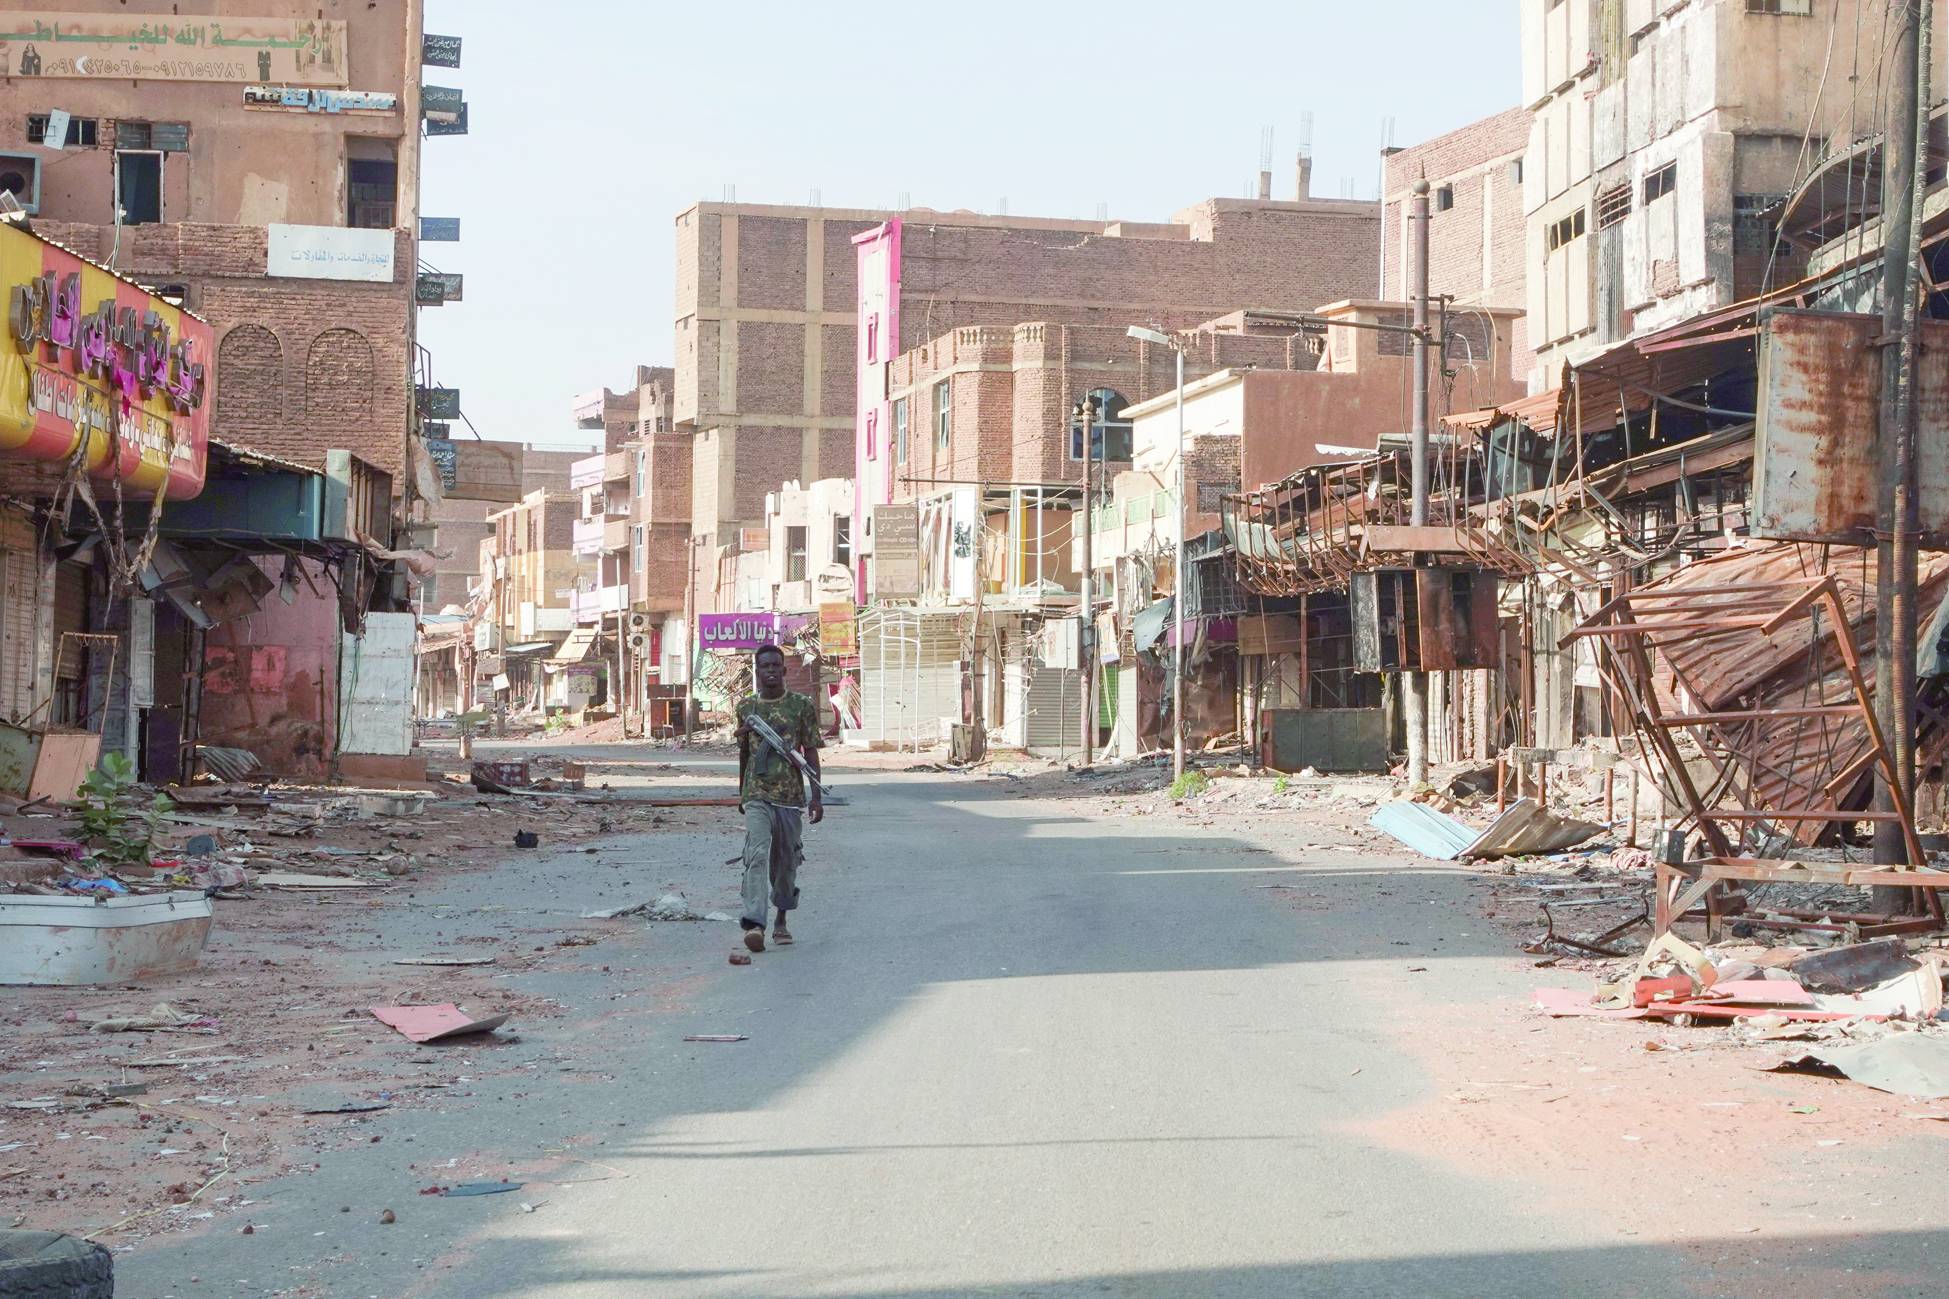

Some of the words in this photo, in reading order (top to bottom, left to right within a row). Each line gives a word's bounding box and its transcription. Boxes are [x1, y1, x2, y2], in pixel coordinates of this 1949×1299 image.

[0, 19, 168, 51] للخياط
[175, 22, 205, 48] الله
[753, 620, 774, 643] دنيا
